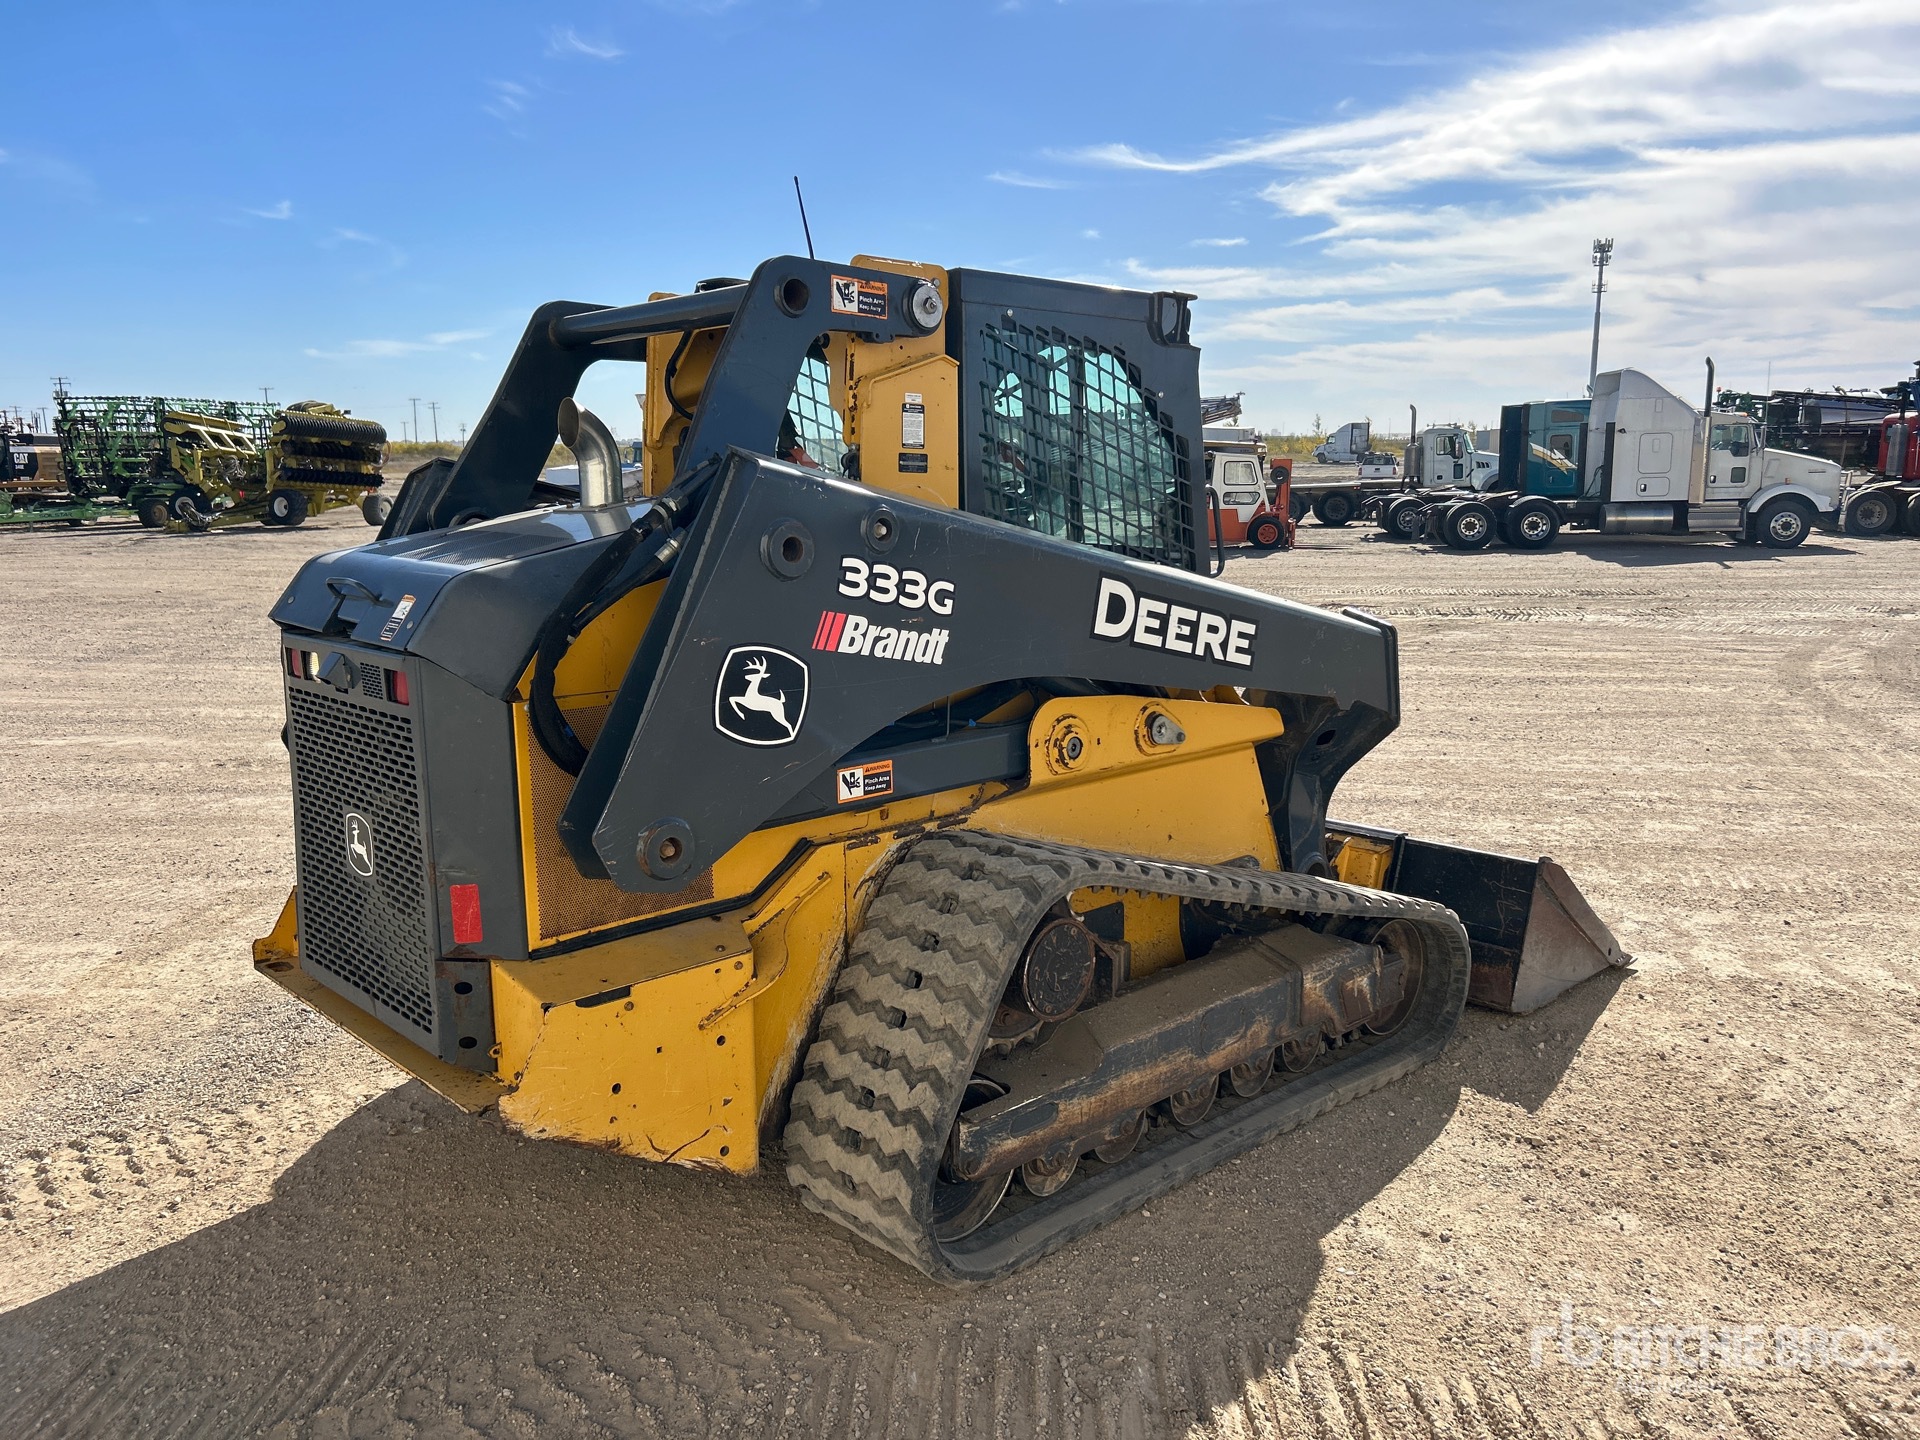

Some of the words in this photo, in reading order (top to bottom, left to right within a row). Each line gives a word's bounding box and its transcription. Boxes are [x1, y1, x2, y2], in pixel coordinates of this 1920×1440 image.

[859, 295, 873, 304] Pinch
[13, 453, 29, 464] CAT
[838, 557, 955, 635] 333G
[1093, 577, 1257, 666] DEERE
[837, 614, 950, 665] Brandt
[869, 763, 890, 772] WARNING
[864, 777, 879, 785] Pinch
